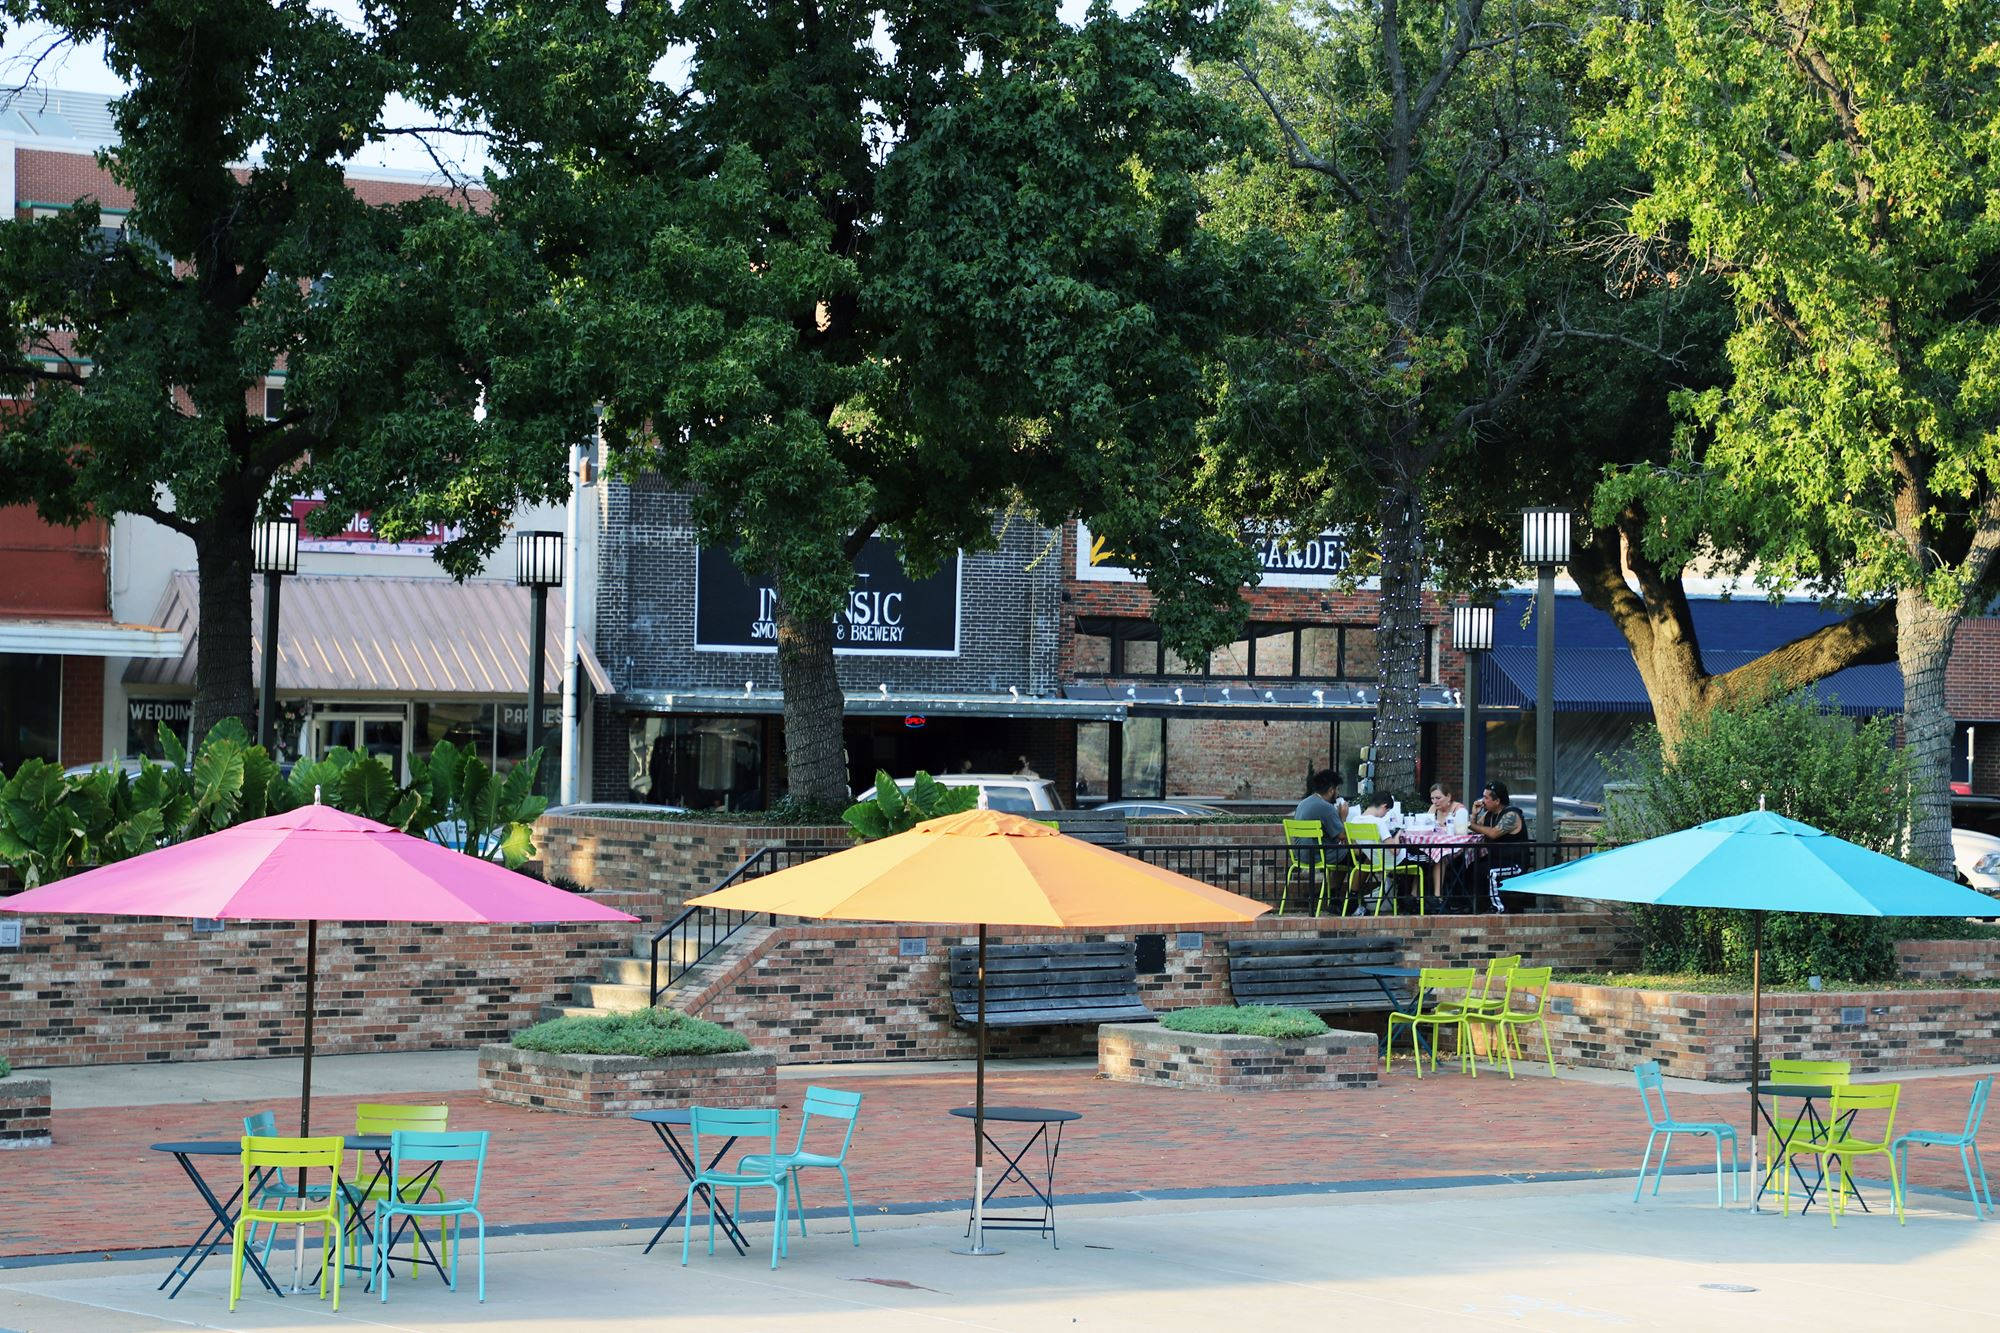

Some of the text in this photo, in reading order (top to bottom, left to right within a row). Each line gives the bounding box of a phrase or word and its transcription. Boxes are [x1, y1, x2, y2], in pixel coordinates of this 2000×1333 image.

[758, 587, 902, 626] INSIC
[836, 624, 904, 642] & BREWERY
[504, 708, 563, 724] PAIES
